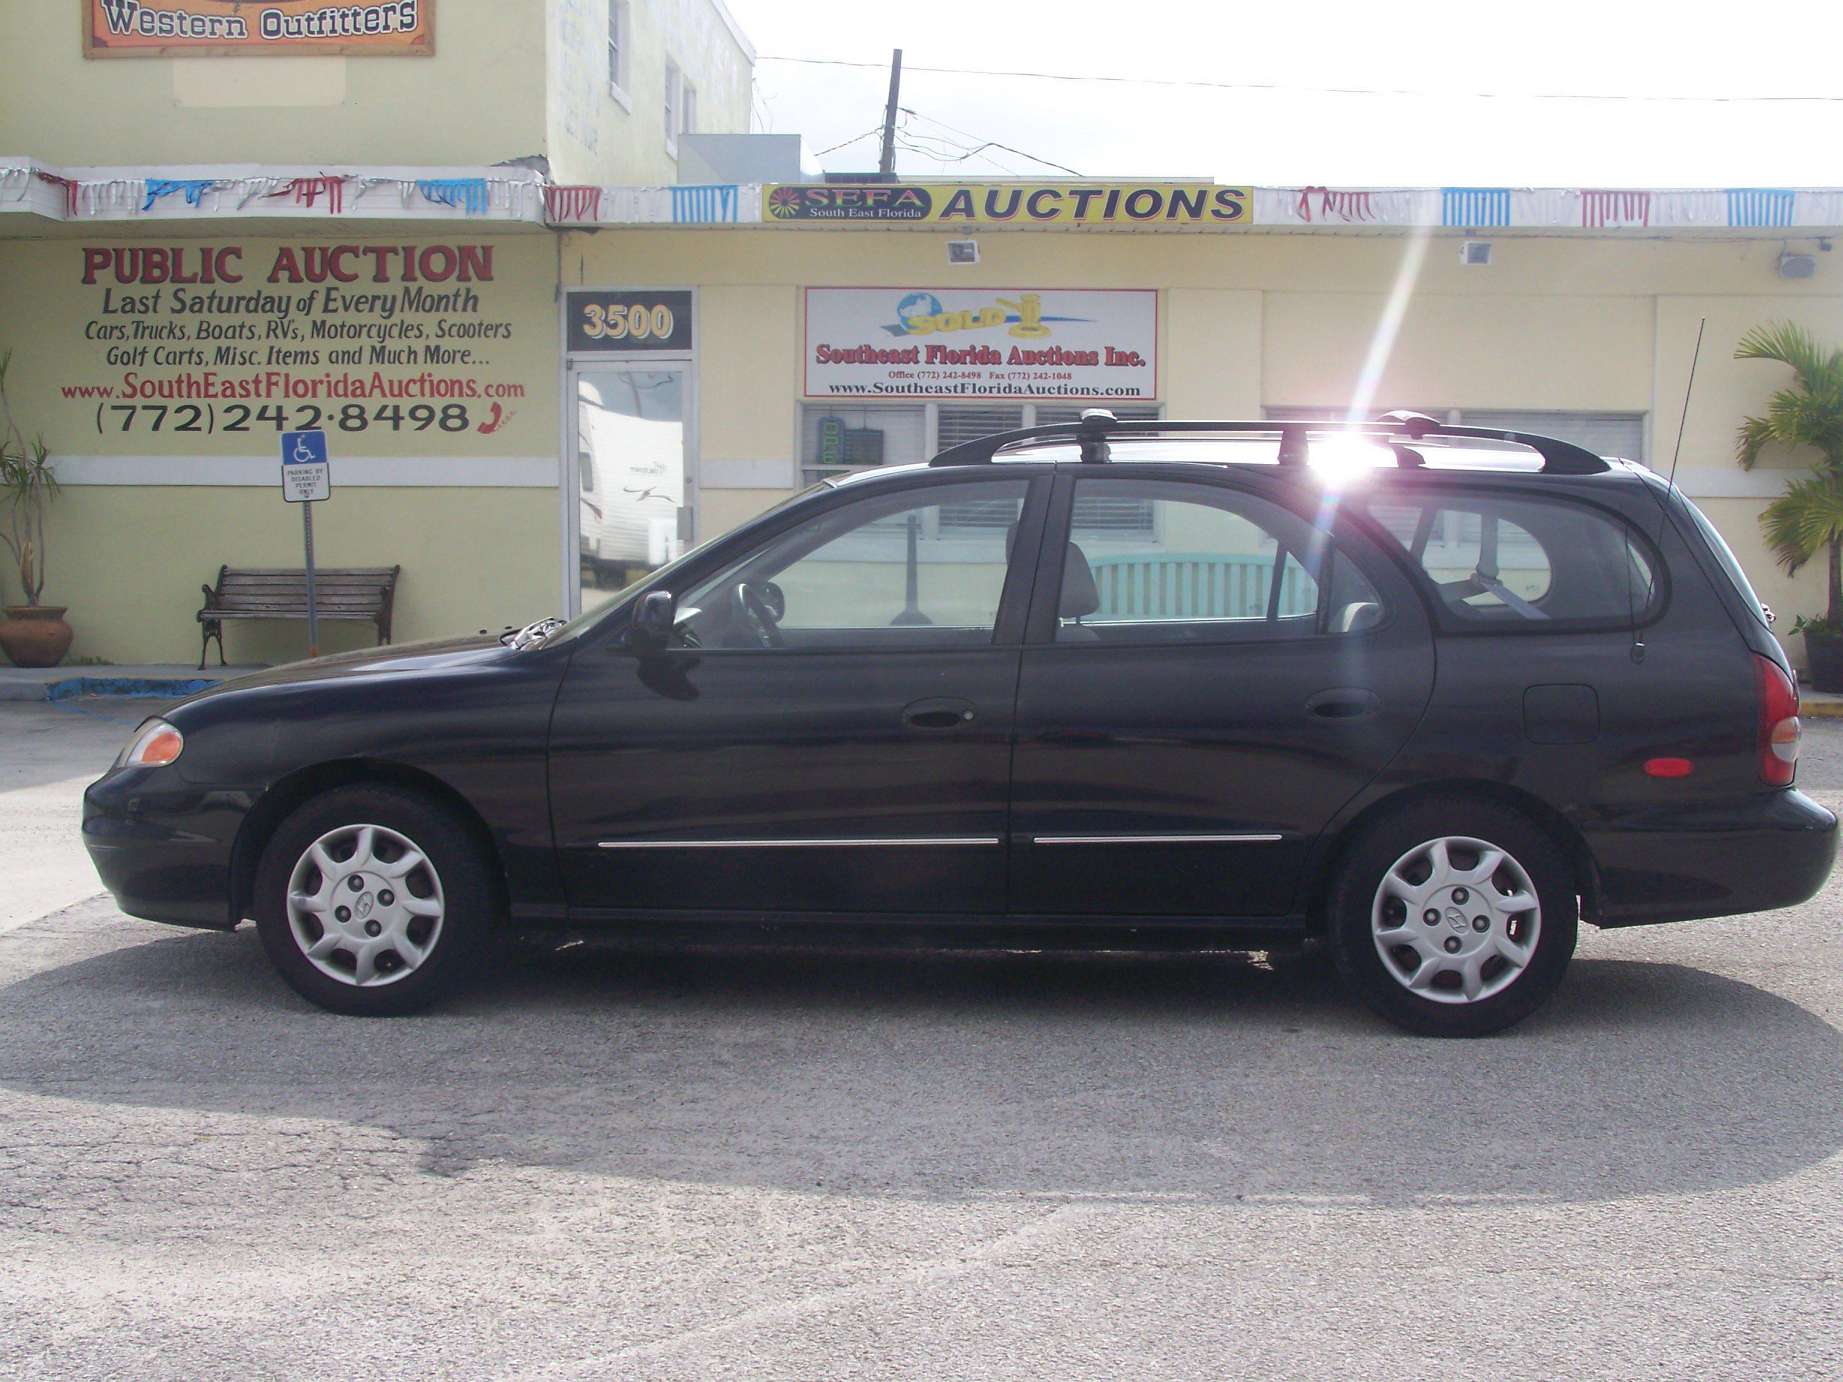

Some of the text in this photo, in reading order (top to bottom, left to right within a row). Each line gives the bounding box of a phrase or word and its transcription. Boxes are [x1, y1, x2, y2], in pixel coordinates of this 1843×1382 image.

[101, 0, 417, 40] Western Outfitters
[804, 188, 1247, 221] SEFA AUCTIONS
[809, 207, 921, 218] South East Florida
[81, 245, 496, 285] PUBLIC AUCTION
[102, 286, 480, 320] Last Saturday of Every Month
[196, 319, 261, 342] Boats,
[310, 318, 430, 343] Motorcycles,
[434, 318, 513, 339] Scooters
[583, 303, 674, 339] 3500
[907, 307, 1005, 336] SOLD
[107, 345, 491, 367] Golf Carts, Misc. Items and Much More...
[816, 343, 1146, 367] Southeast Florida Auctions Inc.
[61, 371, 526, 399] www.SouthEastFloridaAuctions.com
[829, 382, 1141, 396] www.SoutheastFloridaAuctions.com
[888, 371, 915, 380] Office
[917, 370, 940, 381] (772)
[989, 372, 1006, 380] Fax
[1008, 371, 1031, 381] (772)
